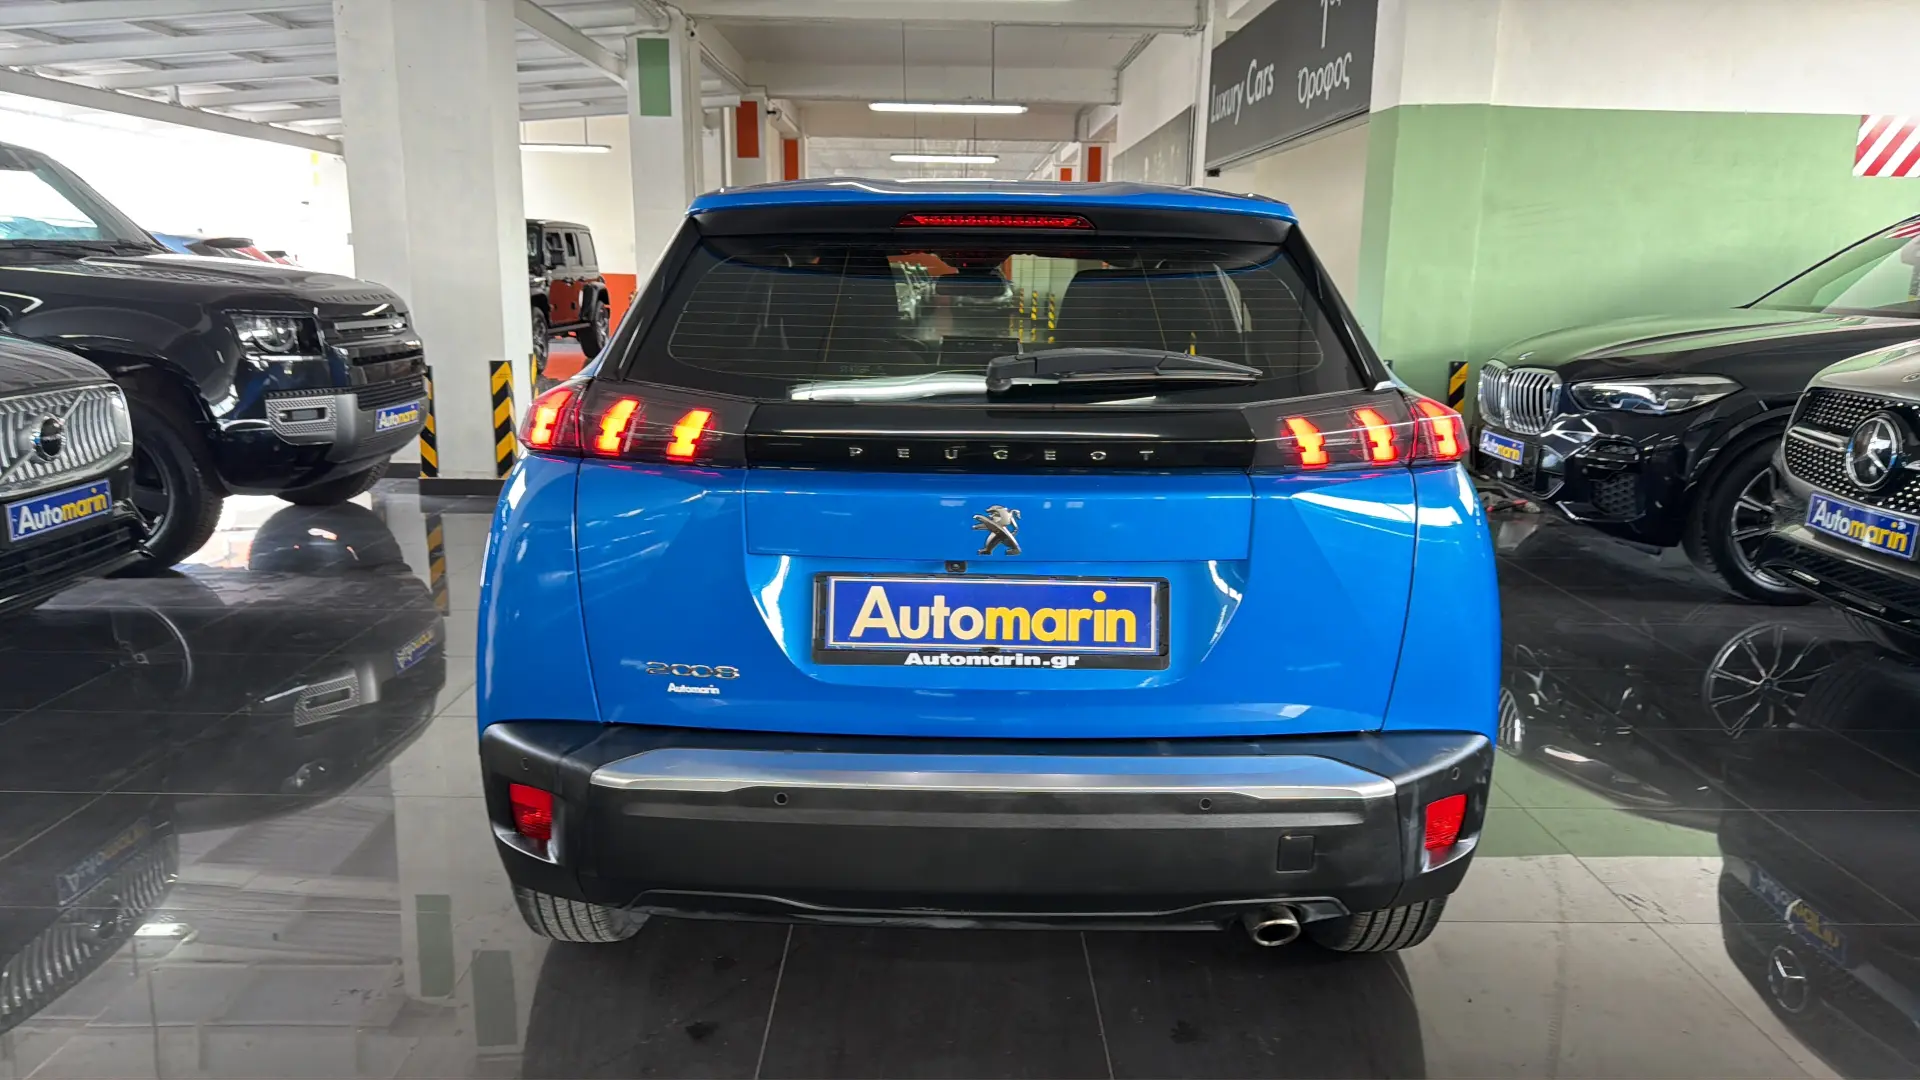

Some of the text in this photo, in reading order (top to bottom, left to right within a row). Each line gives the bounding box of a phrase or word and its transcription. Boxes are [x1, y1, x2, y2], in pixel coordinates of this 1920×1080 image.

[1210, 59, 1275, 125] Luxury Cars
[1298, 52, 1352, 110] Όροφος
[849, 446, 1154, 461] PEUGEOT
[17, 487, 108, 534] Automarin
[1811, 500, 1908, 552] Automarin
[849, 585, 1137, 643] Automarin
[646, 661, 740, 679] 2008
[904, 652, 1079, 669] Automarin.gr
[667, 682, 720, 695] Automarin
